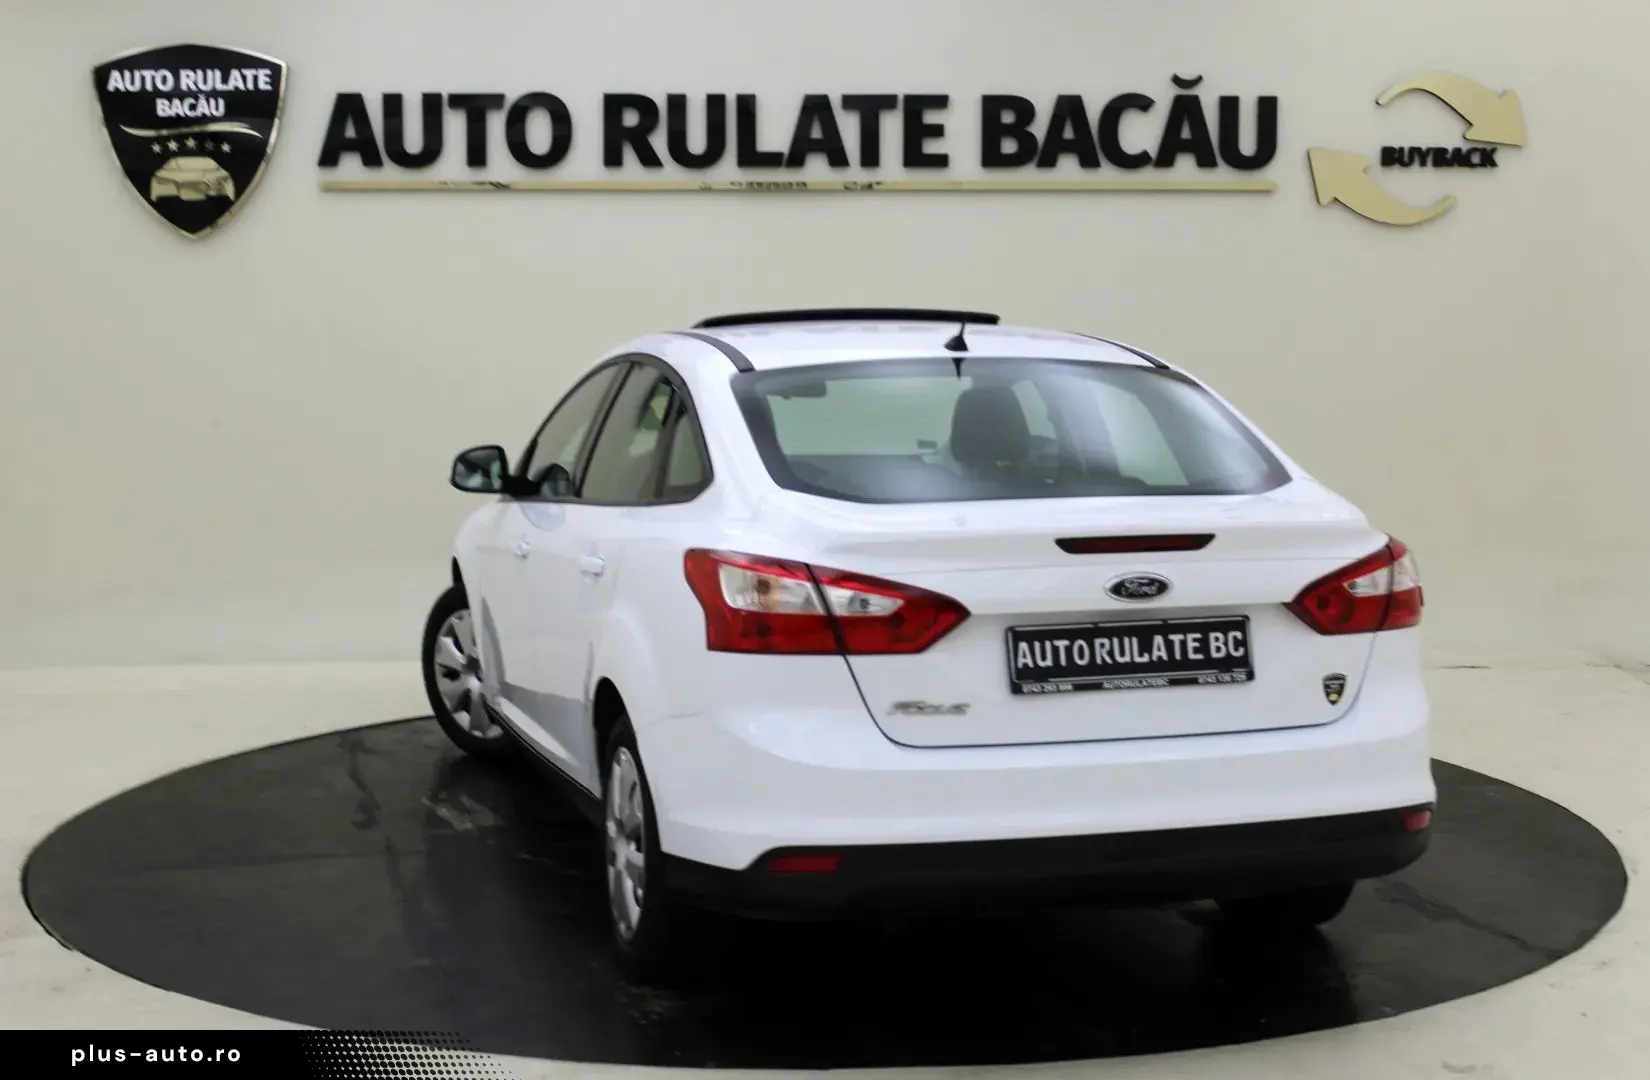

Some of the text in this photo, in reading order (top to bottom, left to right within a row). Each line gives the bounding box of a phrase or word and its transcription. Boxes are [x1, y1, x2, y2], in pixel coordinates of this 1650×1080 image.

[107, 68, 273, 92] AUTO RULATE
[155, 92, 226, 118] BACĂU
[317, 73, 1279, 173] AUTO RULATE BACĂU
[1380, 146, 1499, 169] BUYBACK
[1017, 630, 1246, 668] AUTO RULATE BC
